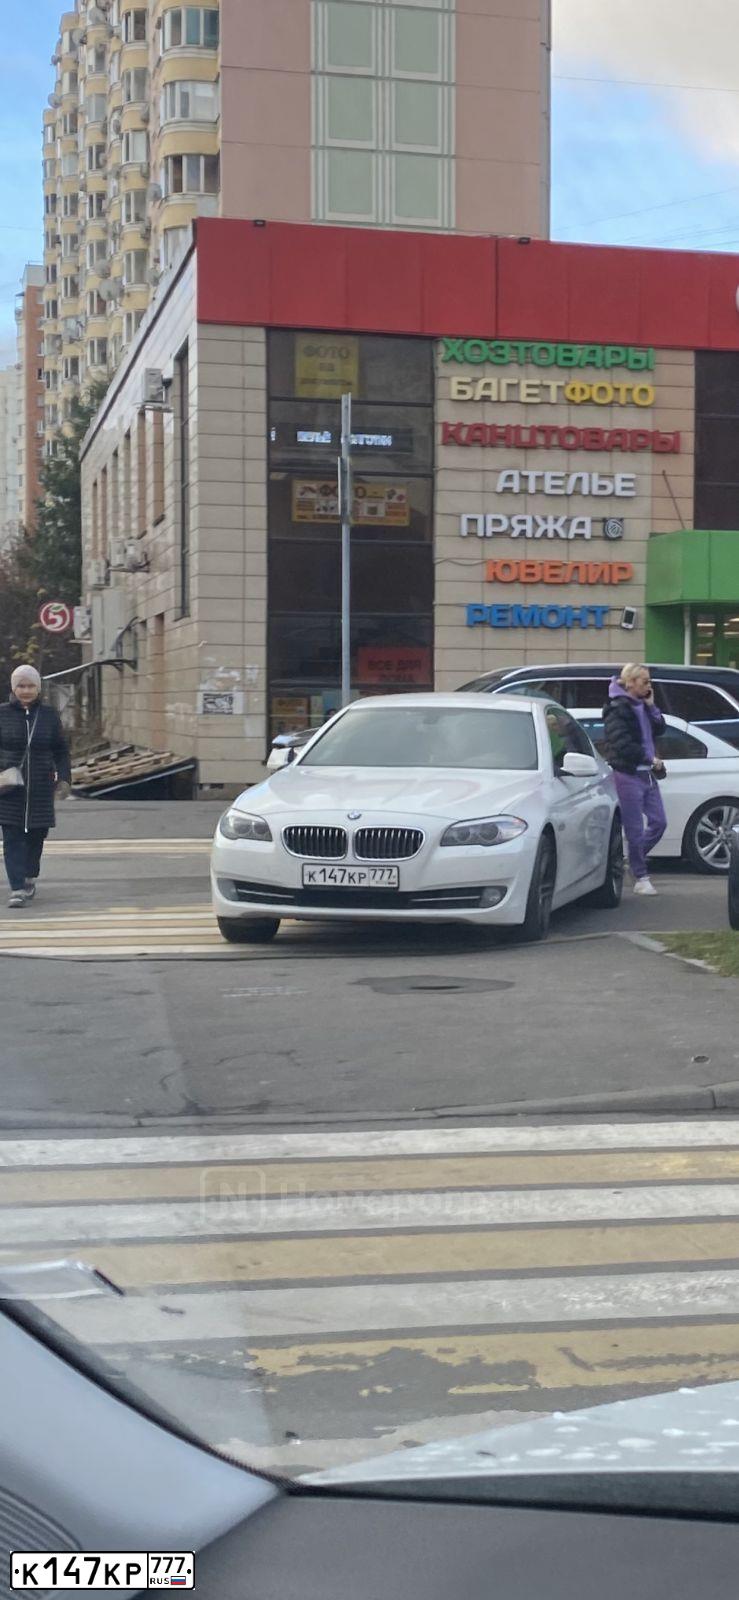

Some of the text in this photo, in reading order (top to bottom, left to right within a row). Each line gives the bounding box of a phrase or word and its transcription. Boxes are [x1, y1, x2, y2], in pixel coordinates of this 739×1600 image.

[441, 338, 656, 371] ХОЗТОВАРЫ
[441, 421, 681, 454] КАНЦТОВАРЫ
[496, 469, 637, 497] АТЕЛЬЕ
[460, 513, 592, 540] ПРЯЖА
[485, 559, 634, 585] ЮВЕЛИР
[465, 603, 611, 629] РЕМОНТ
[307, 867, 394, 884] К147КР 777
